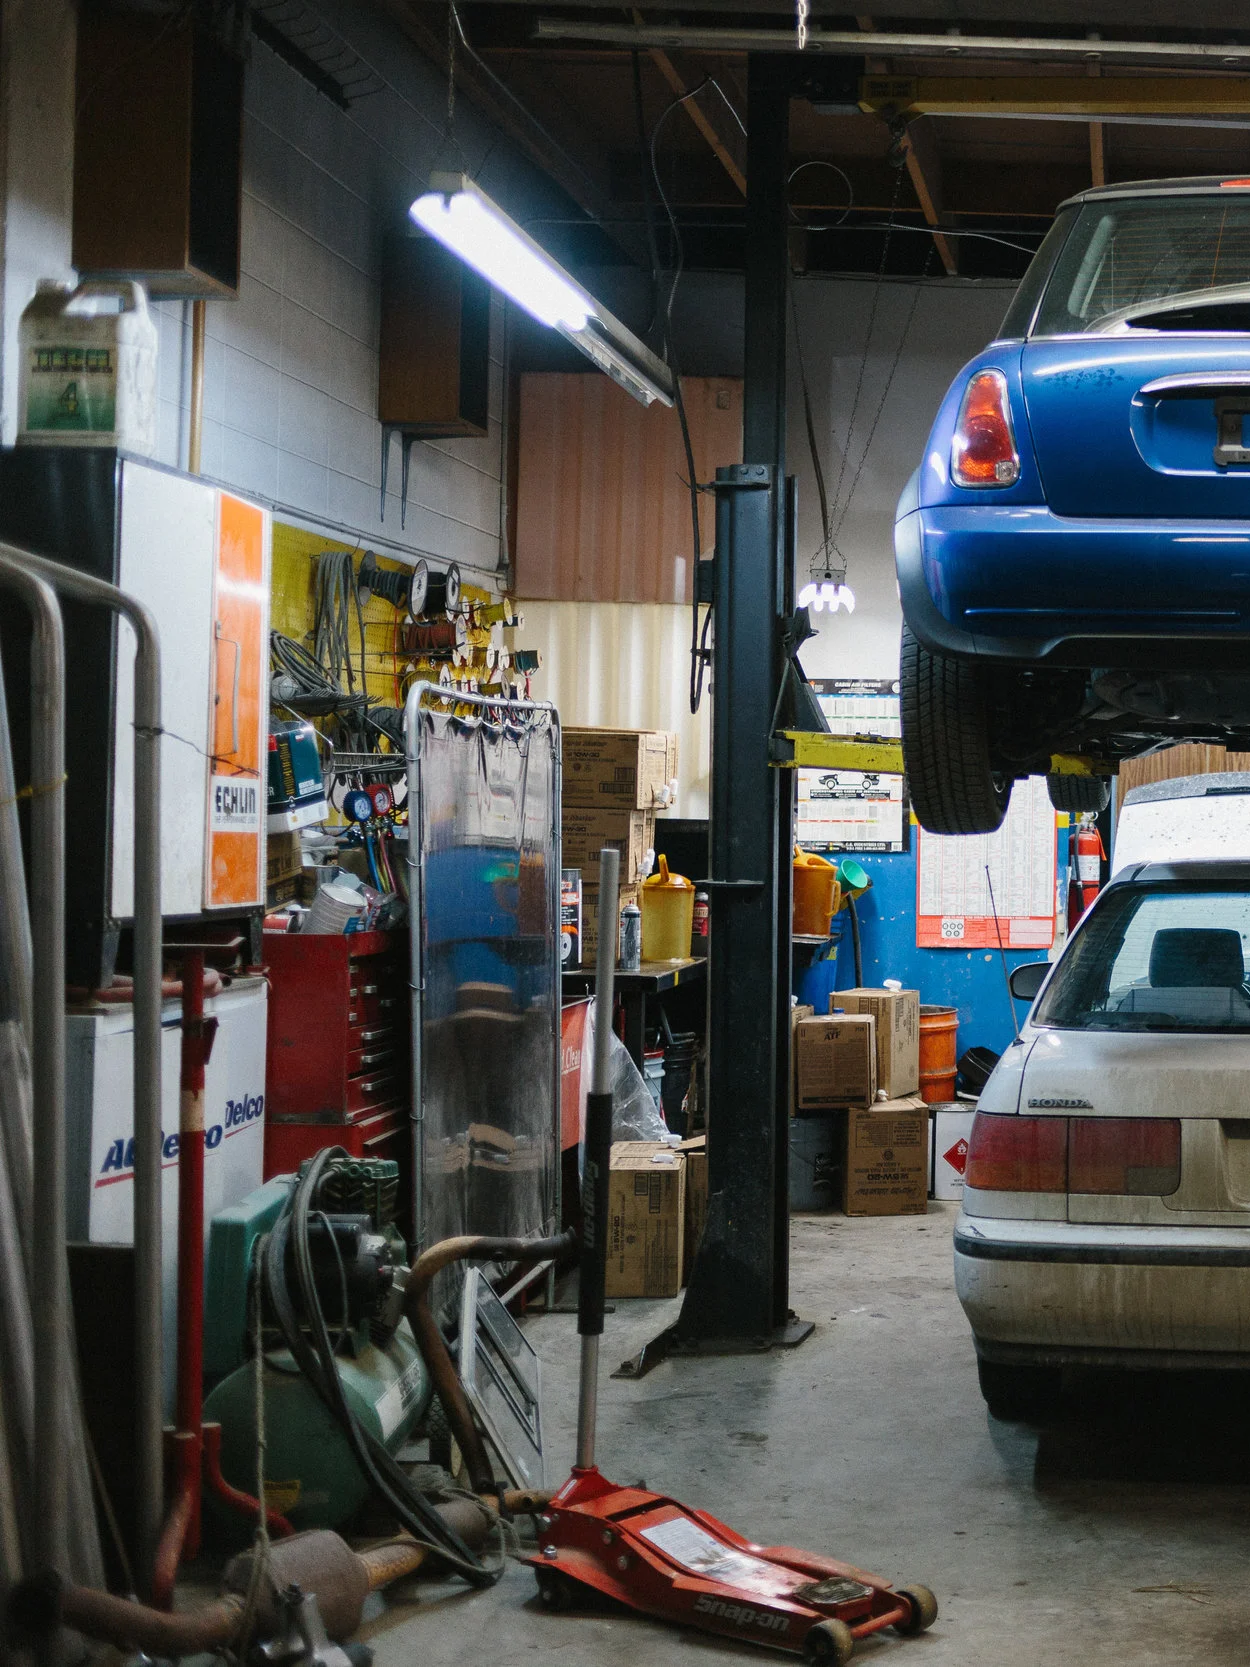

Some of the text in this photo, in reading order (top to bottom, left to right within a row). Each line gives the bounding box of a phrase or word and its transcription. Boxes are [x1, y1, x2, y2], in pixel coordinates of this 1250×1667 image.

[215, 783, 256, 814] ECHLIN
[225, 1094, 264, 1128] Delco
[1028, 1099, 1093, 1108] HONDA
[693, 1593, 791, 1632] Snap-on
